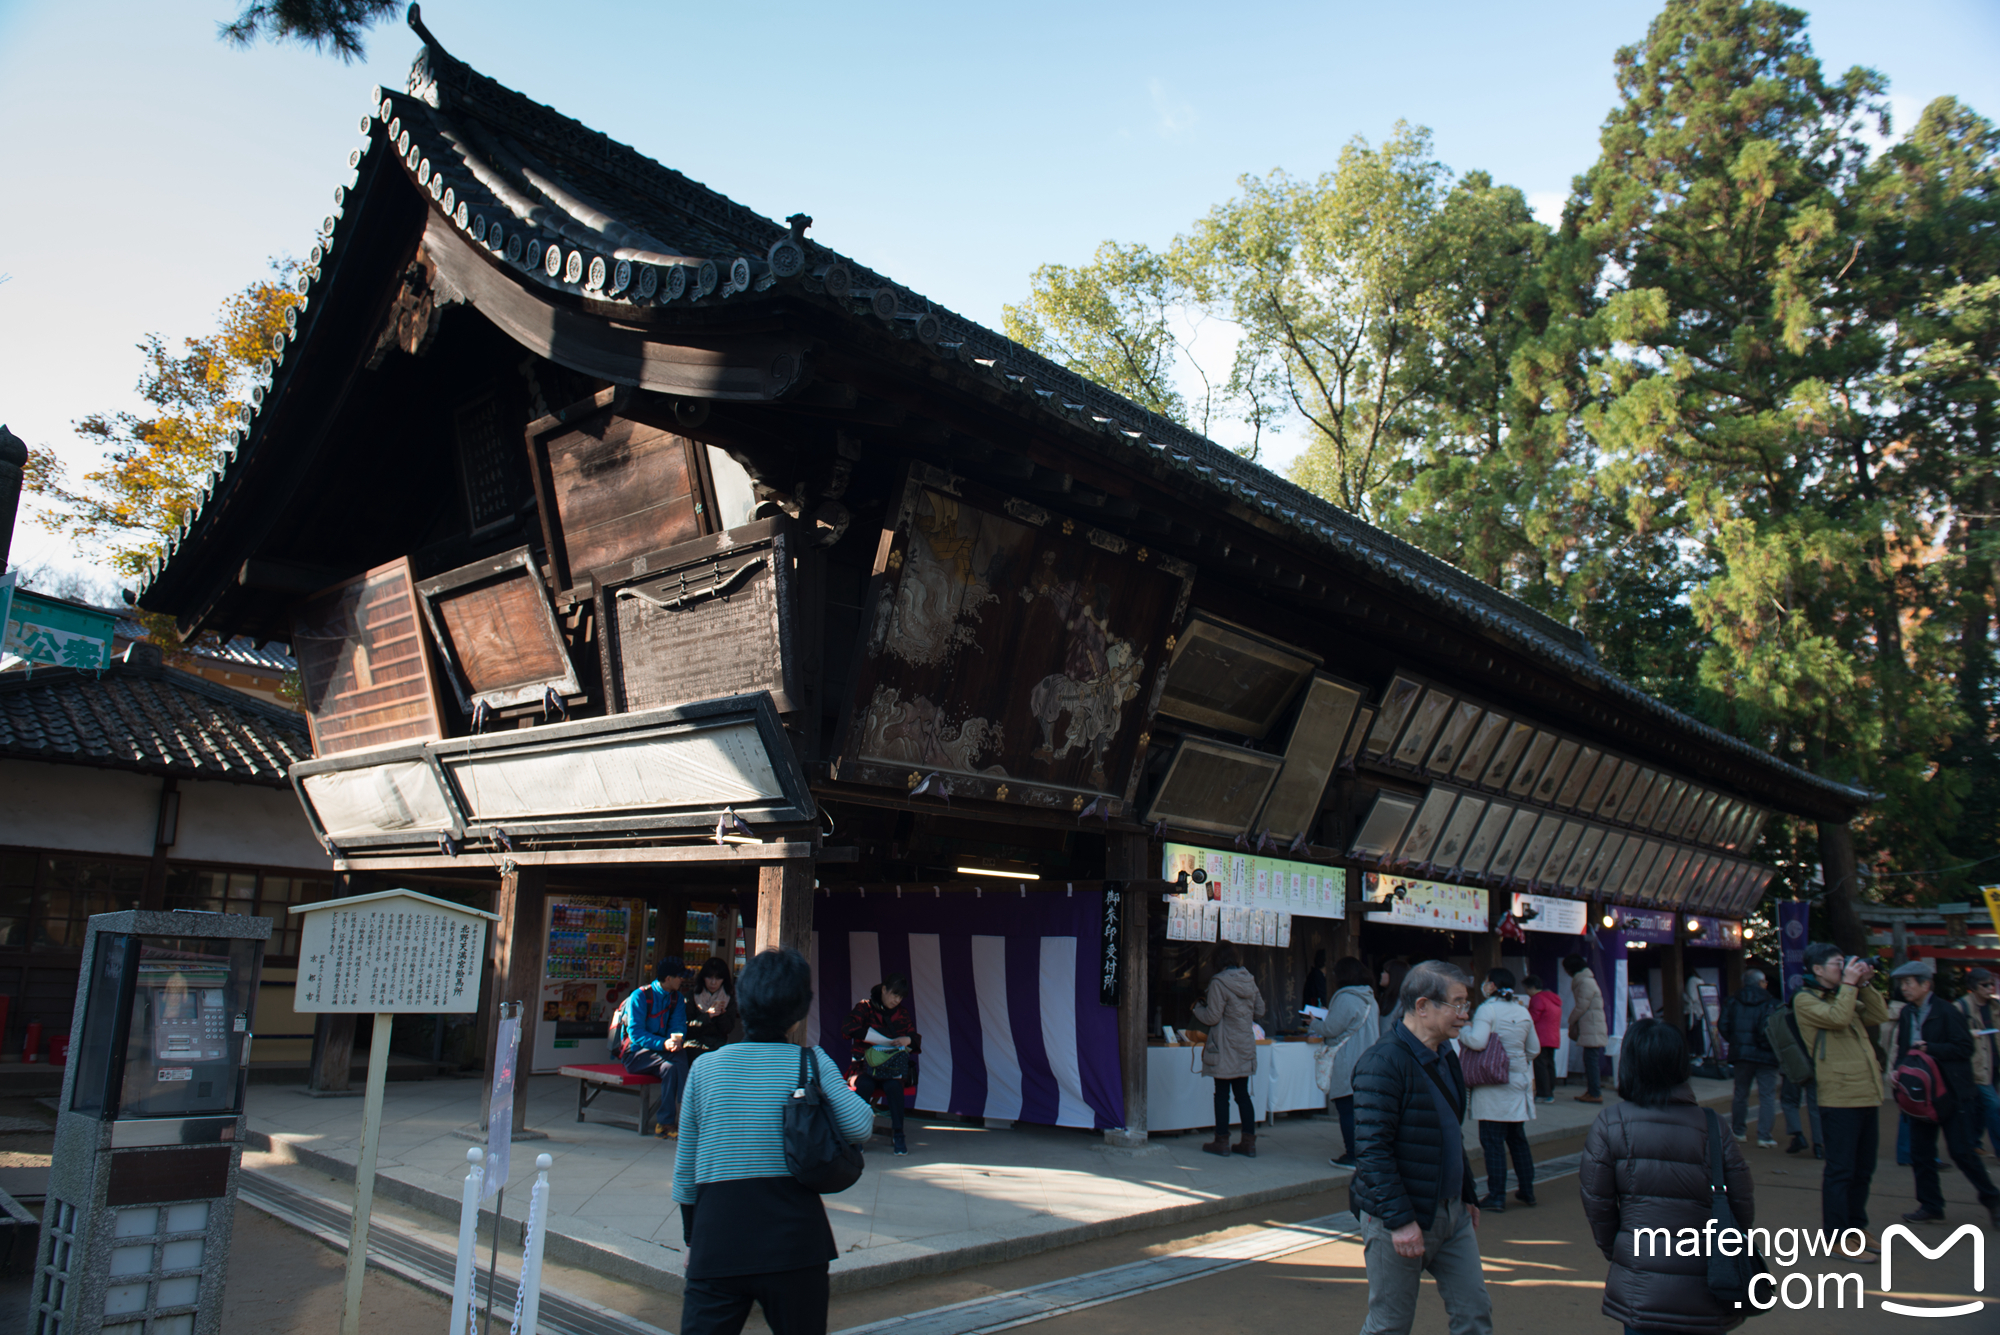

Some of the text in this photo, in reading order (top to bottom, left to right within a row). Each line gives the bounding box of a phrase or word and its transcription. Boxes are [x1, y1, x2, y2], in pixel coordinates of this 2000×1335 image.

[23, 631, 101, 668] 公衆
[453, 924, 470, 997] 北野天満宮絵馬所
[1103, 889, 1121, 997] 御朱印受付所
